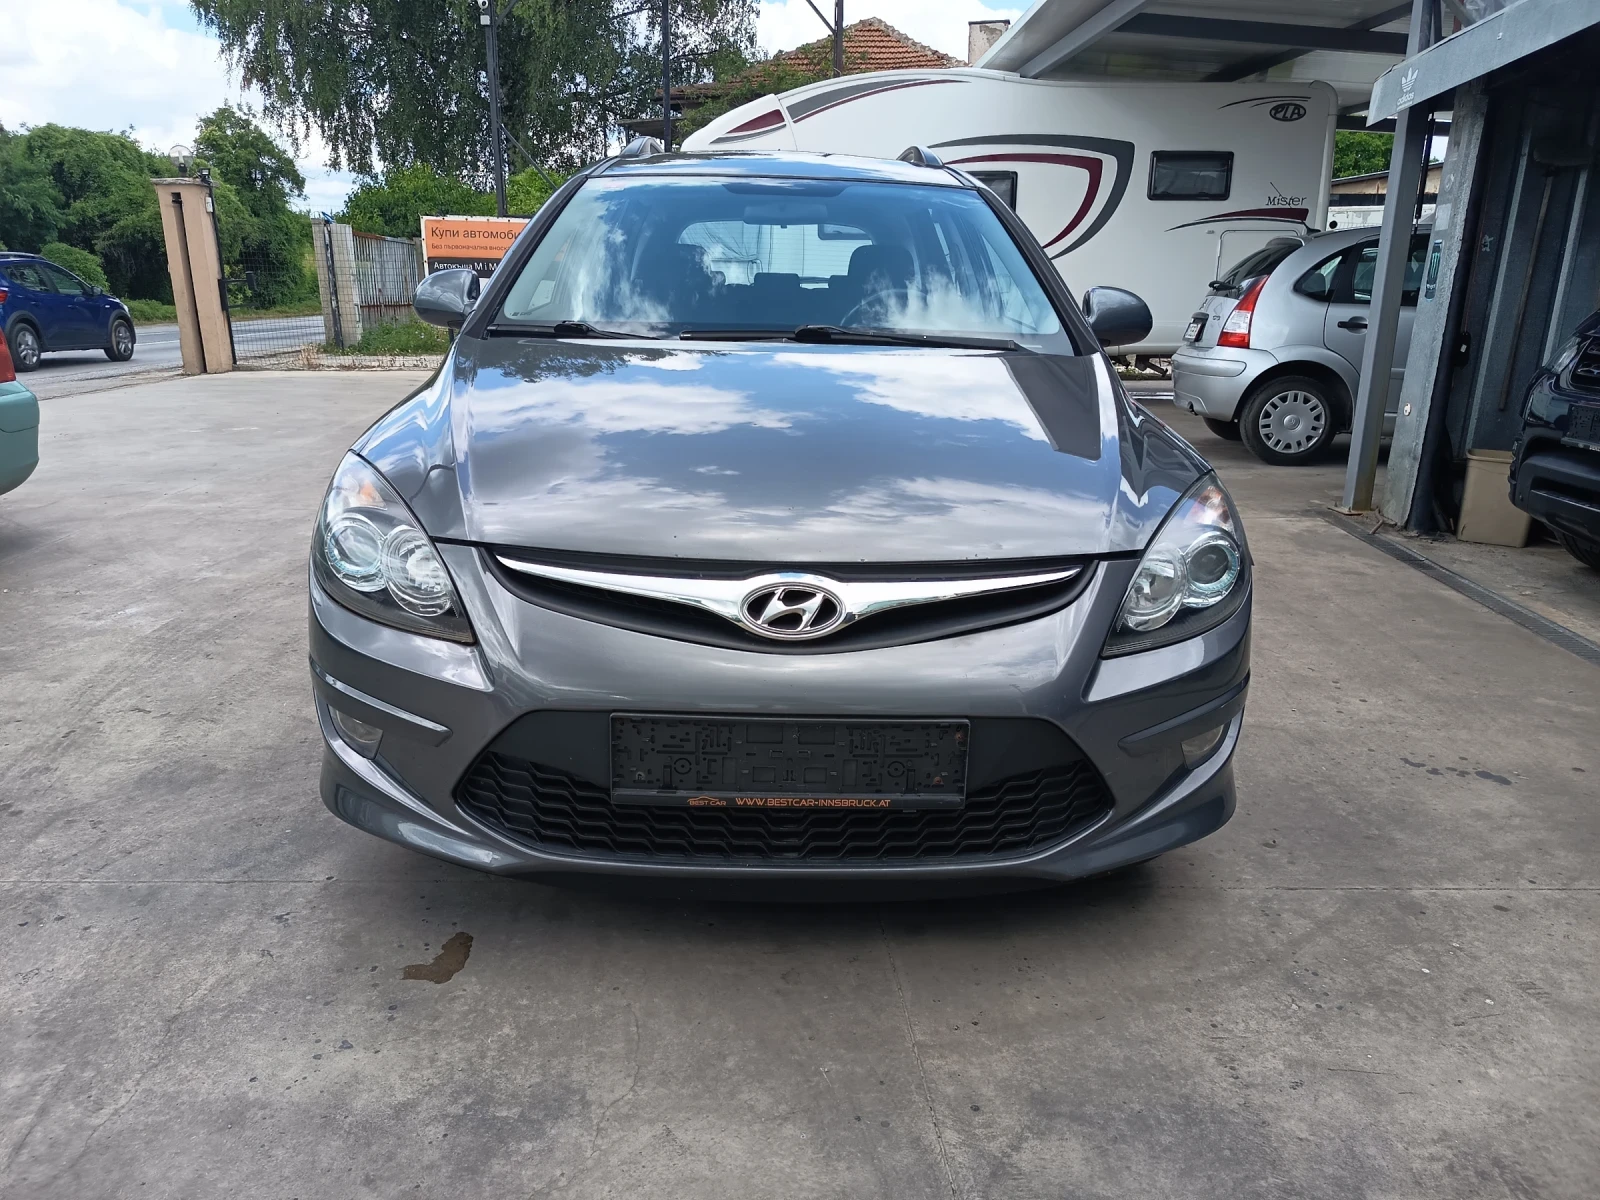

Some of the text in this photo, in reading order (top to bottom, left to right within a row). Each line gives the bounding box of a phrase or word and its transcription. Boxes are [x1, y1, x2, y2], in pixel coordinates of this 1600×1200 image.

[1272, 104, 1304, 119] PLA
[1265, 195, 1307, 207] Mister
[431, 226, 459, 239] Купи
[735, 797, 891, 807] WWW.BESTCAR-INNSBRUCK.AT
